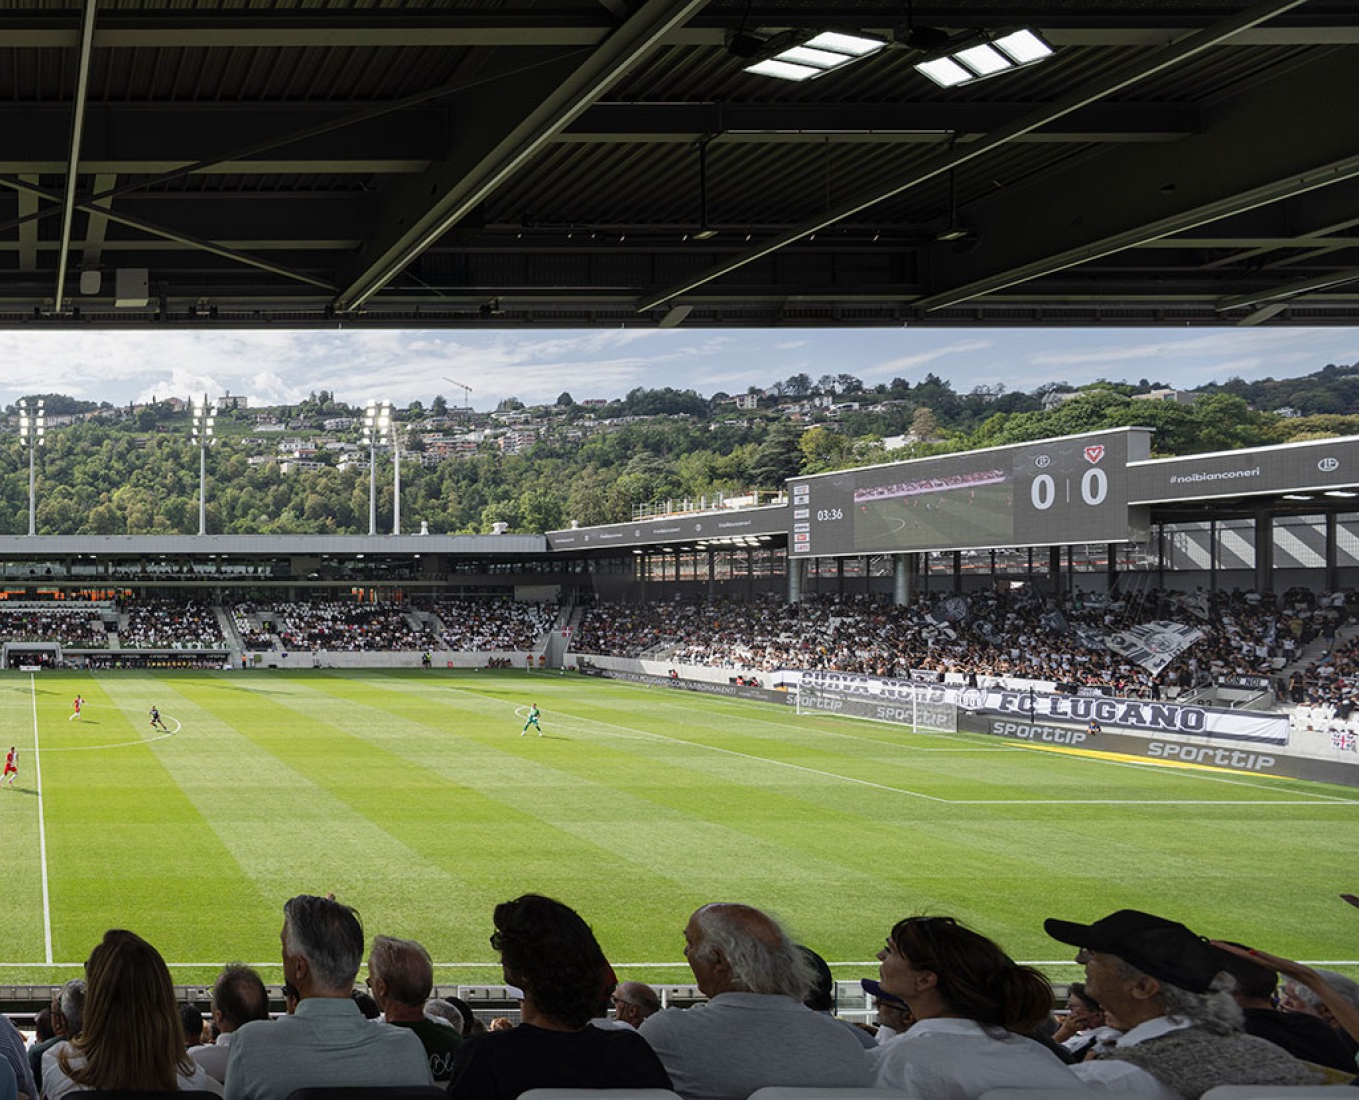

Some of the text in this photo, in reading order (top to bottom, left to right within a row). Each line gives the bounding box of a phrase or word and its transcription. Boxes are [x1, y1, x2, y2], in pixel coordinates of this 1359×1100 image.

[1031, 467, 1108, 510] 0 0
[1170, 467, 1260, 484] #noibianconeri
[817, 508, 844, 521] 03:36
[999, 692, 1038, 714] FC
[1049, 695, 1207, 732] LUGANO
